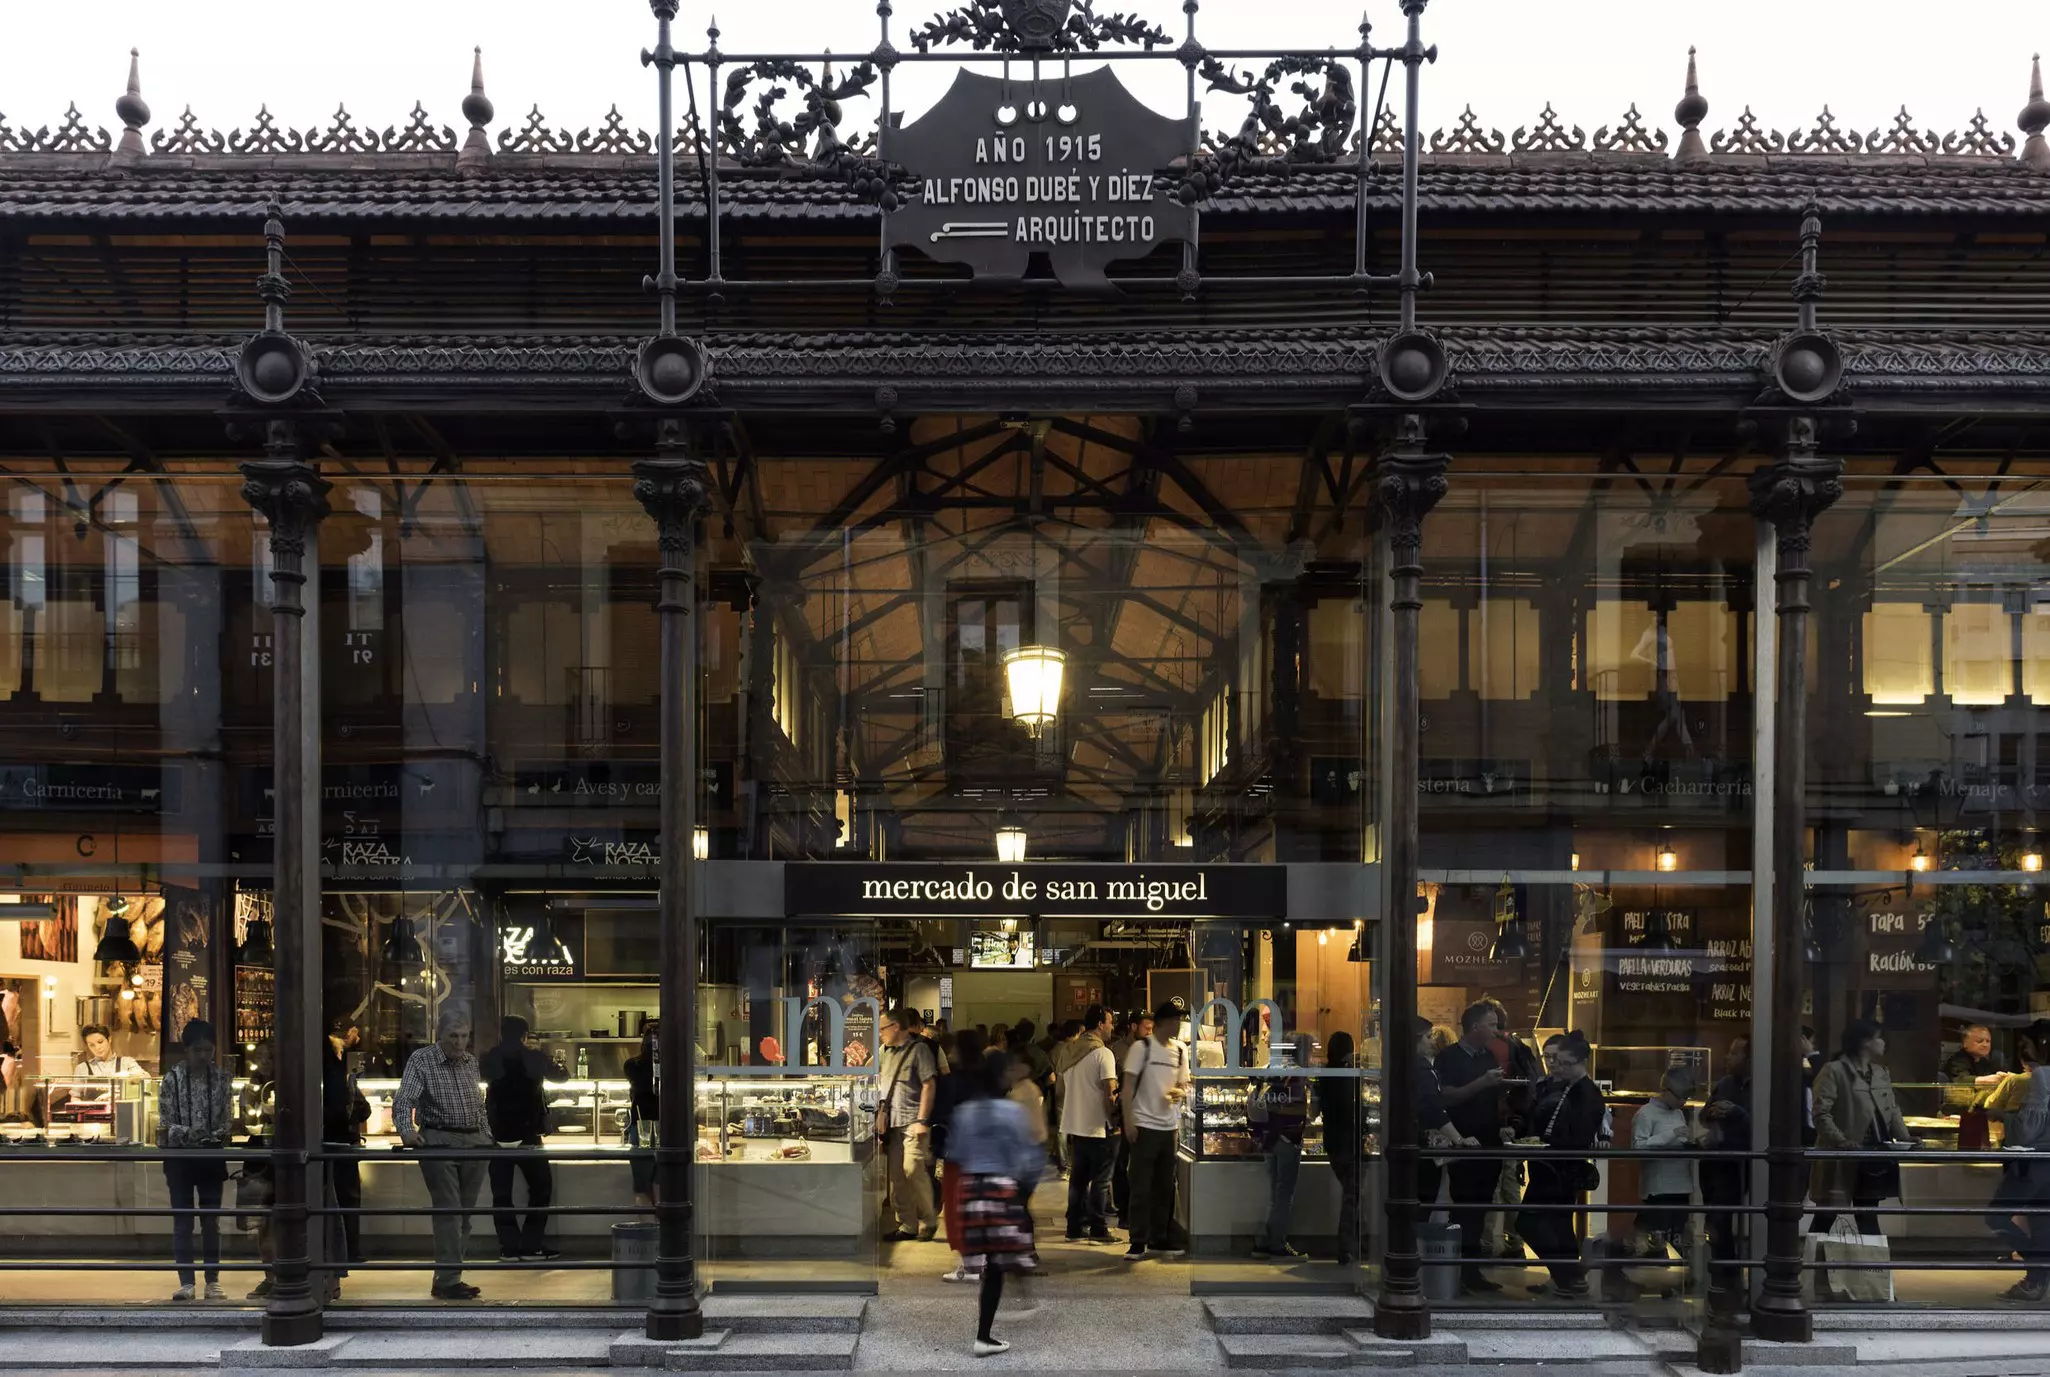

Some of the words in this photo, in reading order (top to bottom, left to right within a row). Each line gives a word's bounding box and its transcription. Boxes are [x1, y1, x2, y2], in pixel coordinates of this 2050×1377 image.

[975, 131, 1025, 163] AÑO
[1045, 133, 1101, 162] 1915
[923, 178, 1019, 204] ALFONSO
[1026, 168, 1080, 202] DUBÉ
[1090, 178, 1100, 201] Y
[23, 777, 123, 802] Carnicería
[321, 780, 399, 800] rnicería
[573, 776, 617, 796] Aves
[621, 782, 631, 801] y
[1418, 775, 1472, 793] stería
[1641, 775, 1752, 796] Cacharrería
[1939, 778, 2008, 801] Menaje
[343, 842, 389, 857] RAZA
[605, 842, 652, 857] RAZA
[863, 871, 992, 902] mercado
[1001, 871, 1036, 901] de
[1045, 881, 1097, 902] san
[1105, 873, 1207, 911] miguel
[547, 966, 574, 976] raza
